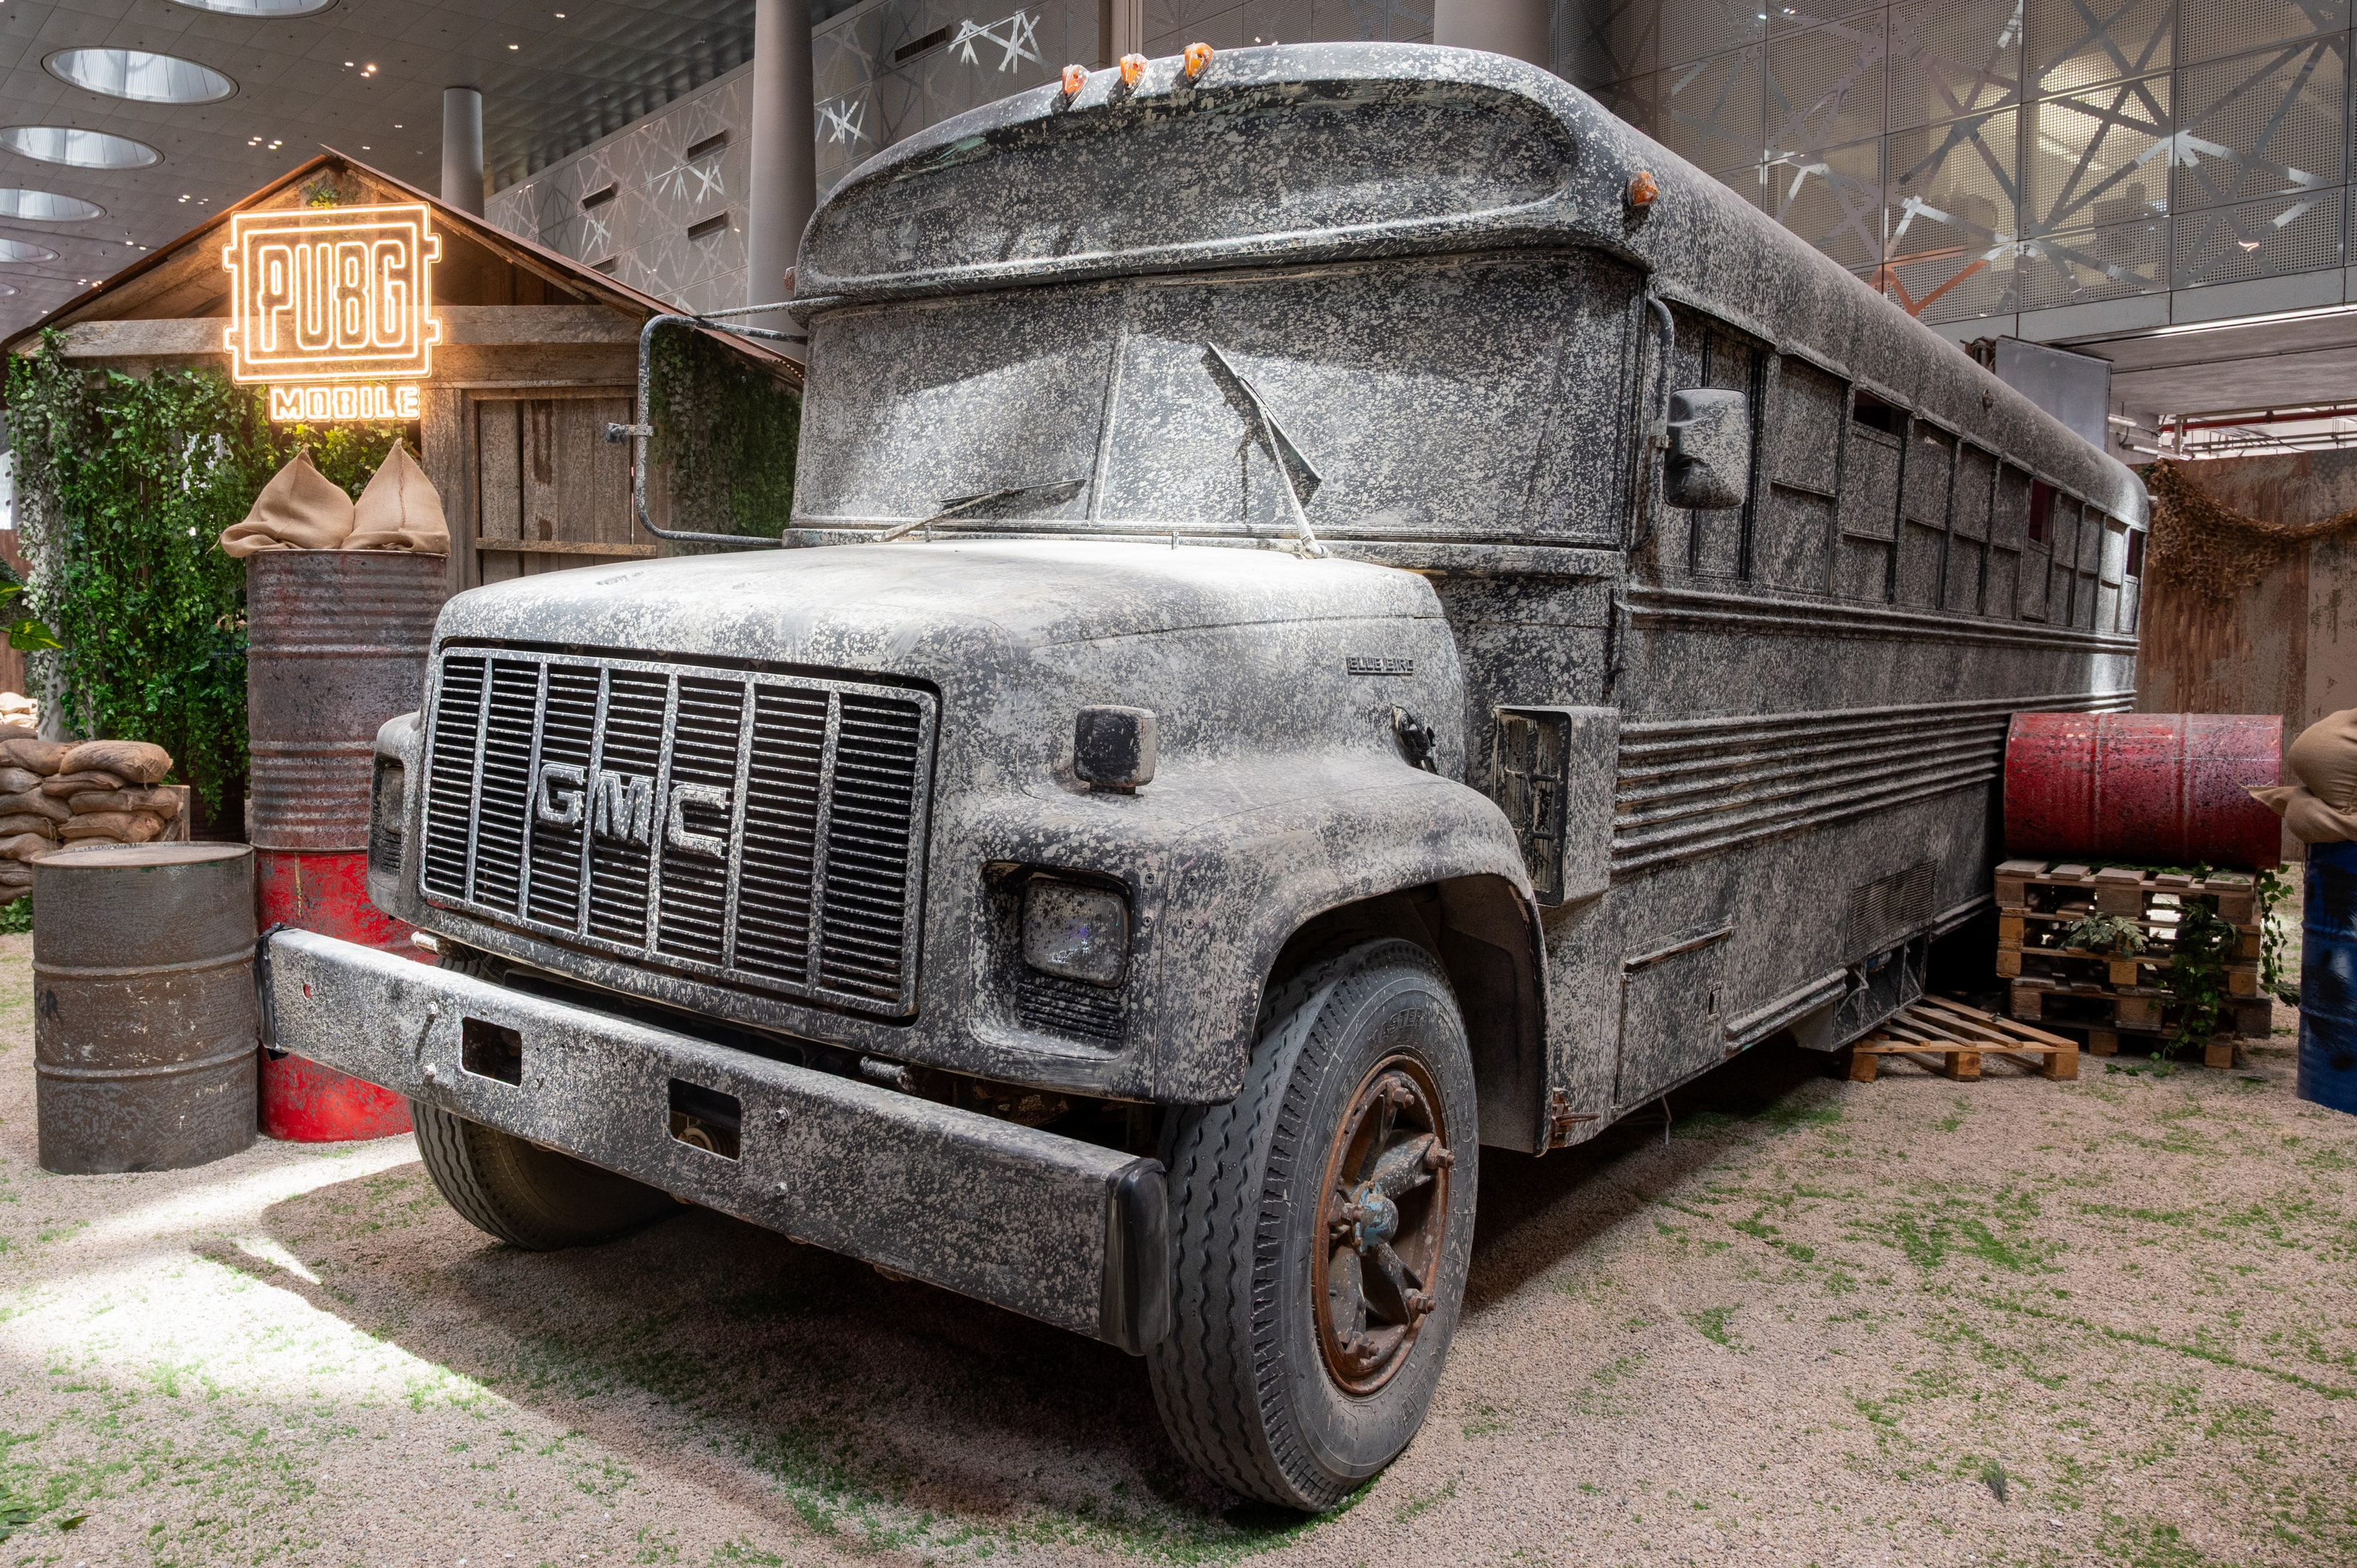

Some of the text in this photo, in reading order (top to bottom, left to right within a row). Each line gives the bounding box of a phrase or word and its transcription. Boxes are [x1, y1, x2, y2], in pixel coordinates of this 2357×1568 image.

[257, 239, 407, 354] PUBG
[270, 384, 421, 422] MOBILE
[537, 763, 727, 857] GMC
